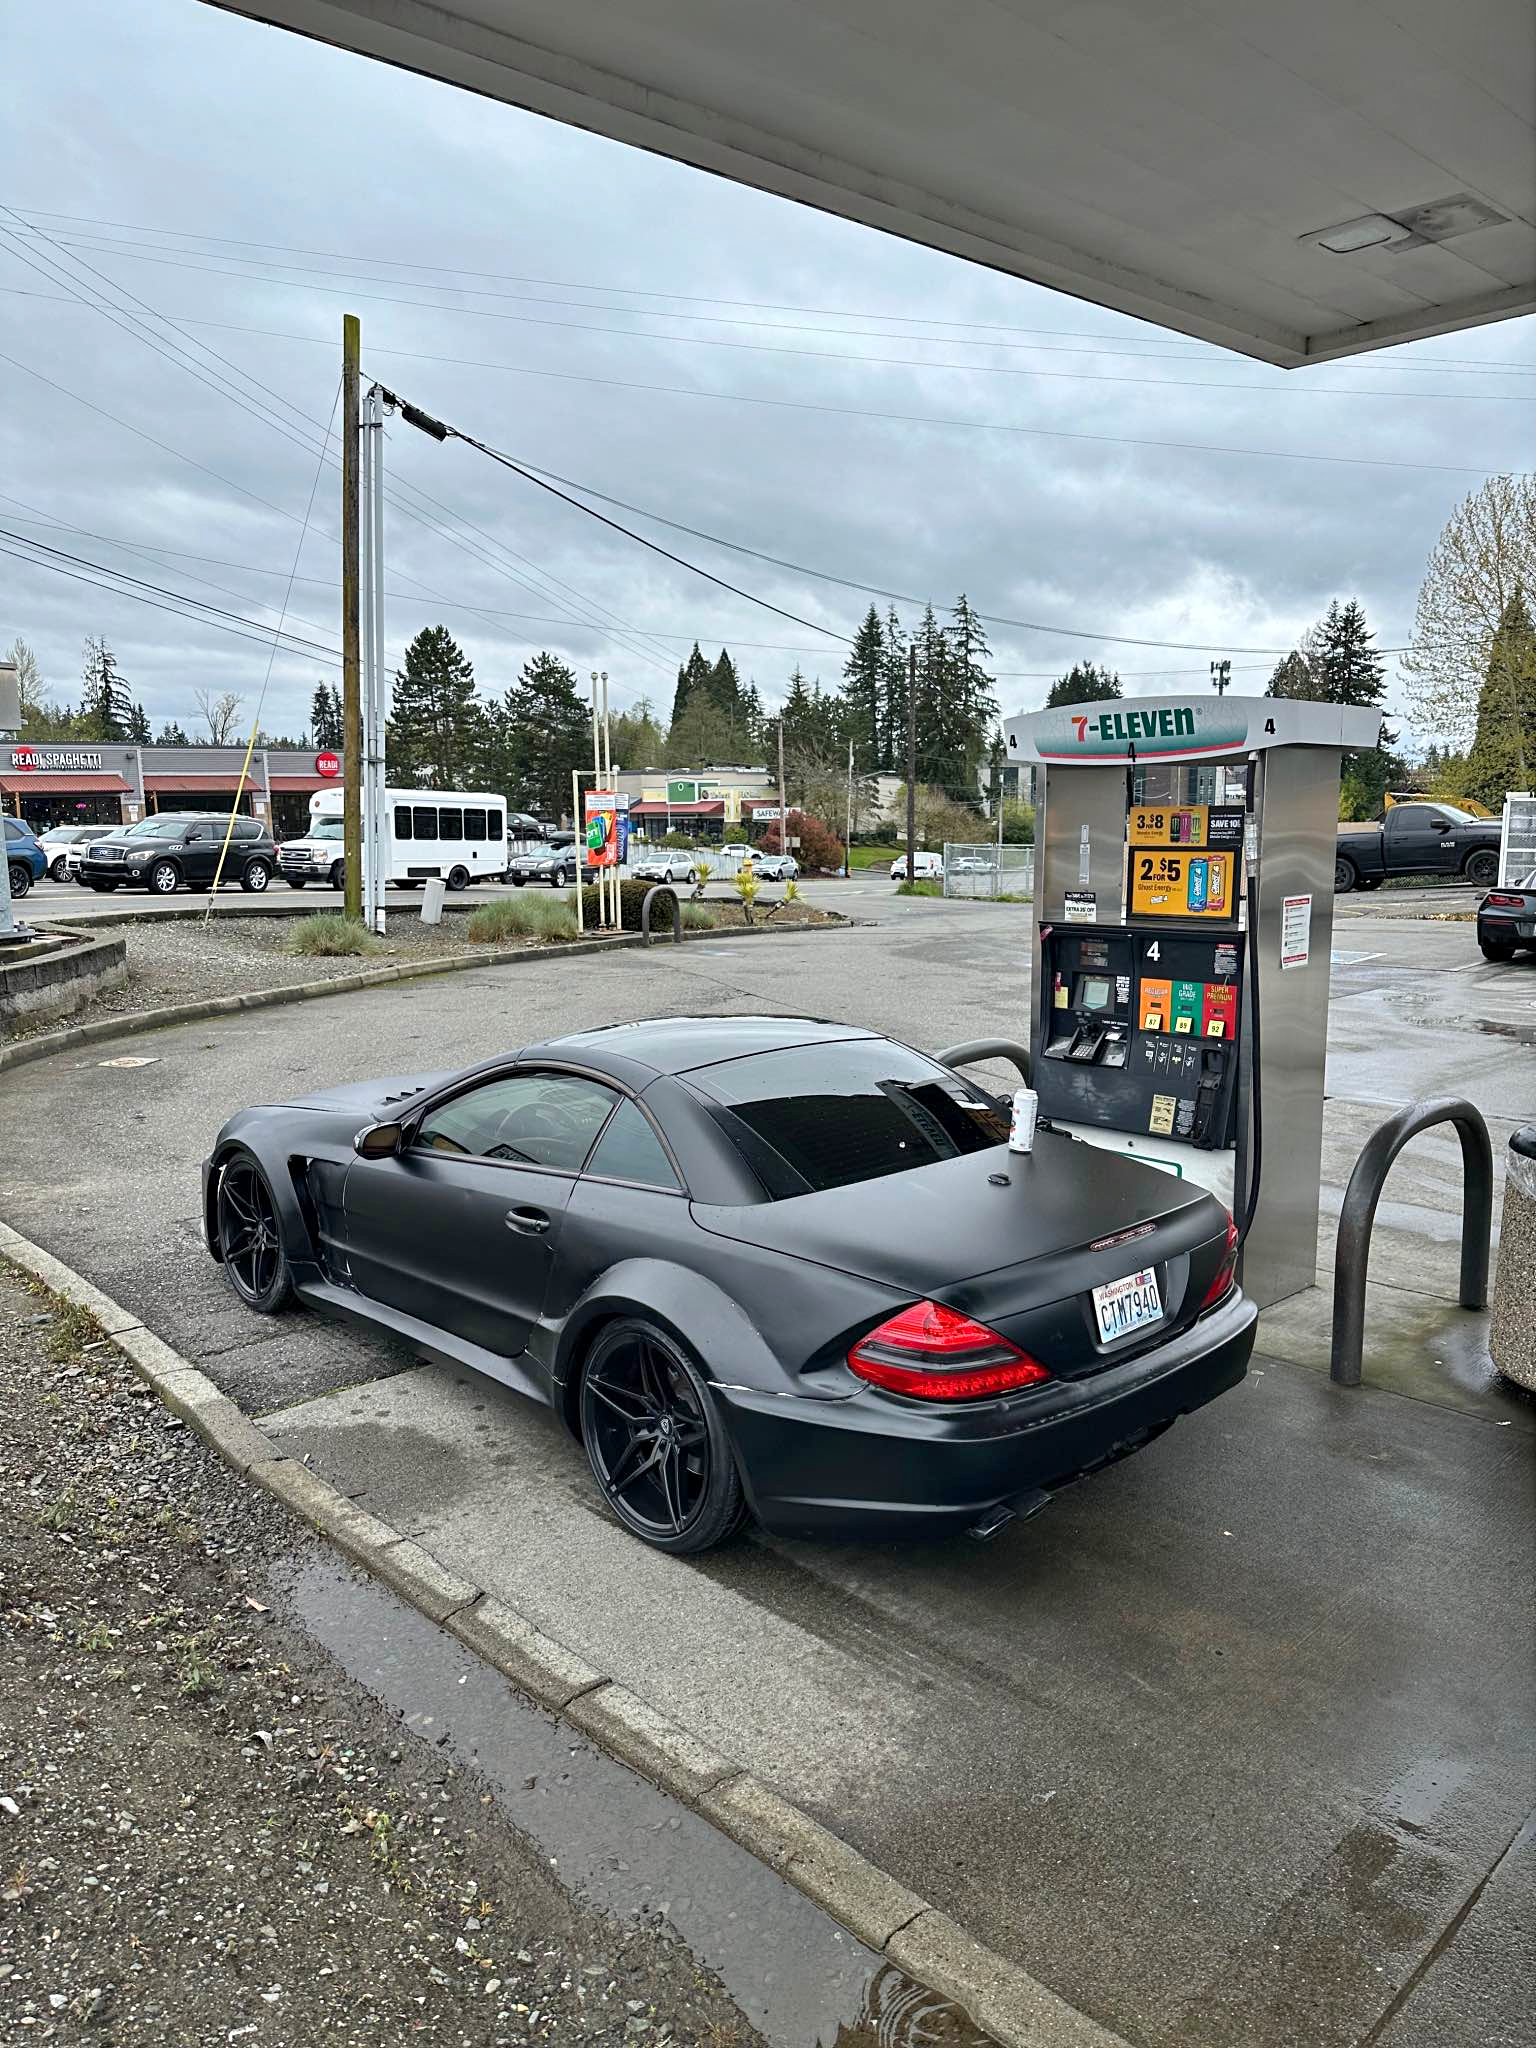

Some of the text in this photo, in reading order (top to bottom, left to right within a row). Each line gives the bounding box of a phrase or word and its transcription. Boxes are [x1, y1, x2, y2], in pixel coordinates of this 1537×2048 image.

[1071, 707, 1195, 742] 7-ELEVEN
[1265, 718, 1276, 734] 4
[1009, 734, 1017, 749] 4
[11, 753, 102, 766] READI SPAGHETTI
[1127, 742, 1136, 763] 4
[319, 760, 338, 769] READI
[756, 809, 793, 817] SAFEW
[1137, 814, 1146, 829] 3
[1210, 819, 1229, 828] SAVE
[1140, 857, 1181, 881] 2 FOR $5
[1154, 884, 1172, 892] Energy
[1146, 941, 1160, 961] 4
[1211, 985, 1229, 993] SUPER
[1099, 1282, 1134, 1300] WASHINGTON
[1101, 1285, 1158, 1332] CTM7940
